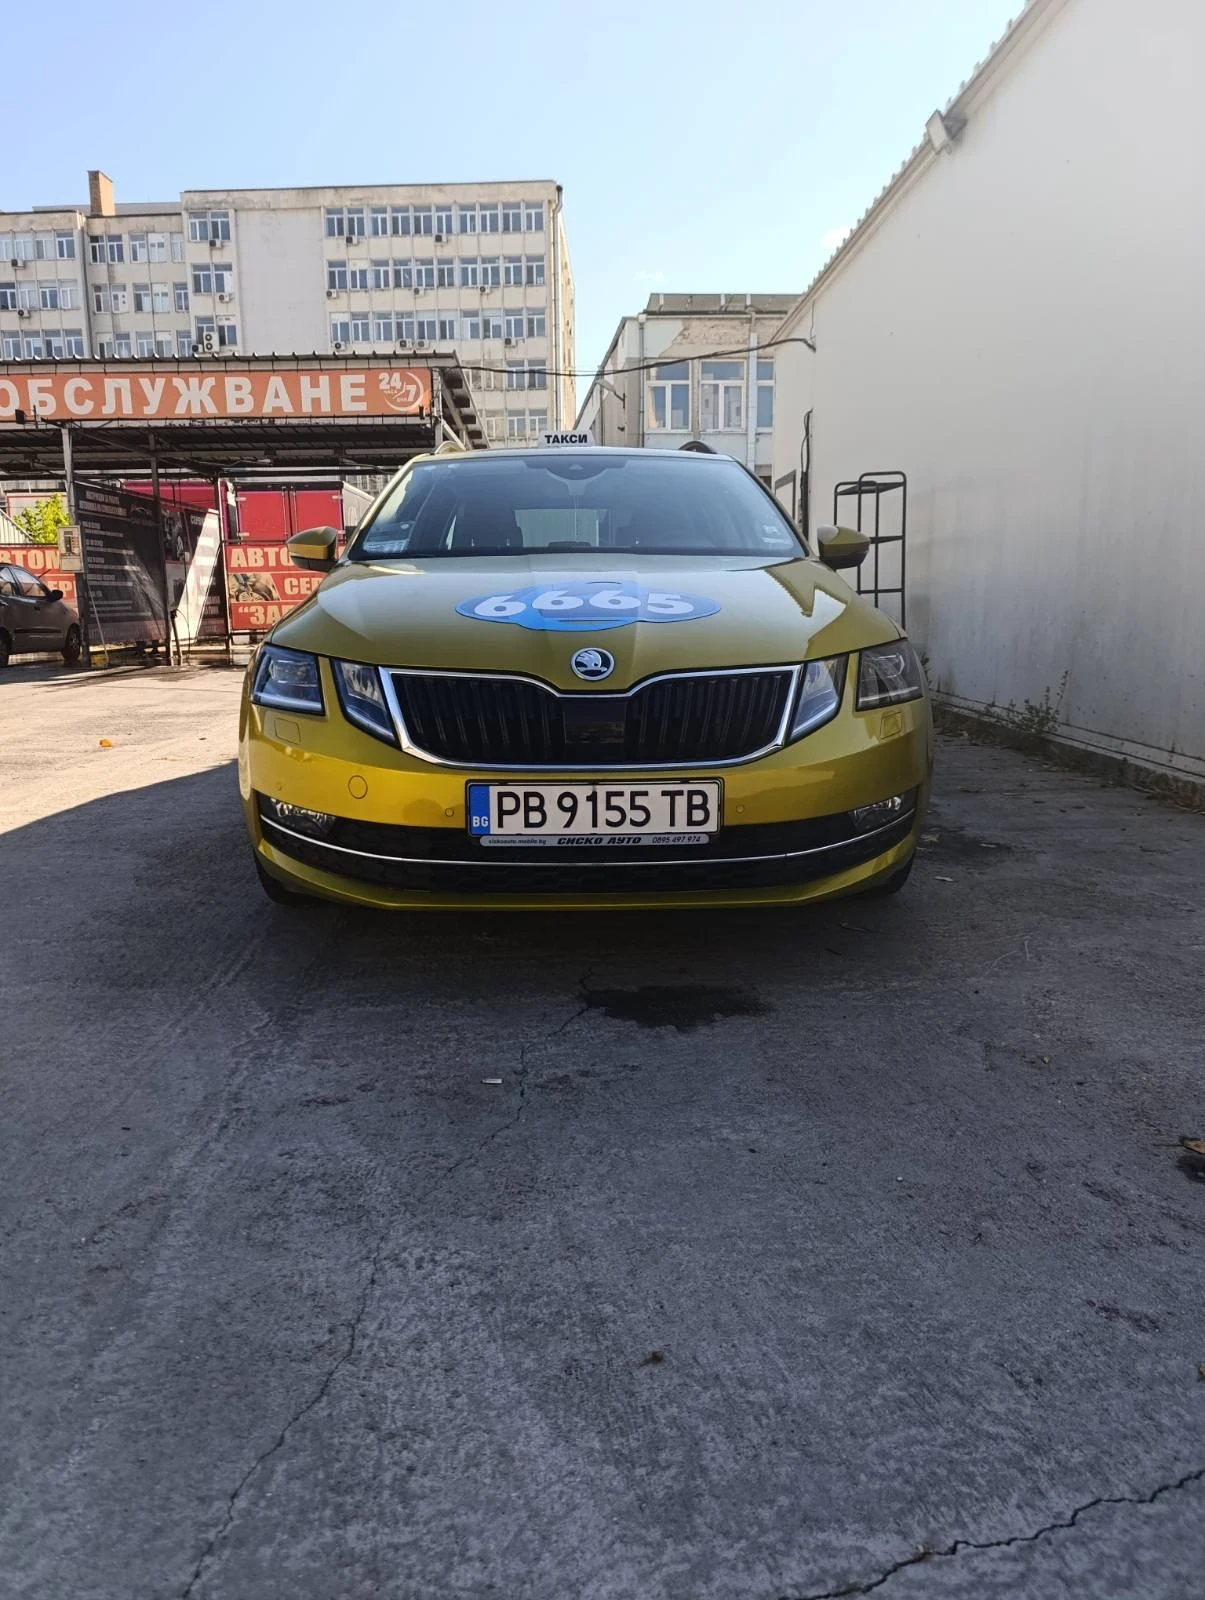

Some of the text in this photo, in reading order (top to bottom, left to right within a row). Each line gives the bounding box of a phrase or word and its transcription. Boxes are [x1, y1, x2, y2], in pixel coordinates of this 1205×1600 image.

[379, 372, 401, 390] 24
[0, 374, 367, 417] ОБСЛУЖВАНЕ
[406, 384, 417, 402] 7
[544, 434, 588, 444] ТАКСИ
[473, 589, 695, 617] 6665
[497, 790, 711, 829] PB 9155 TB
[472, 816, 489, 828] BG
[652, 835, 701, 844] 0895 497 974
